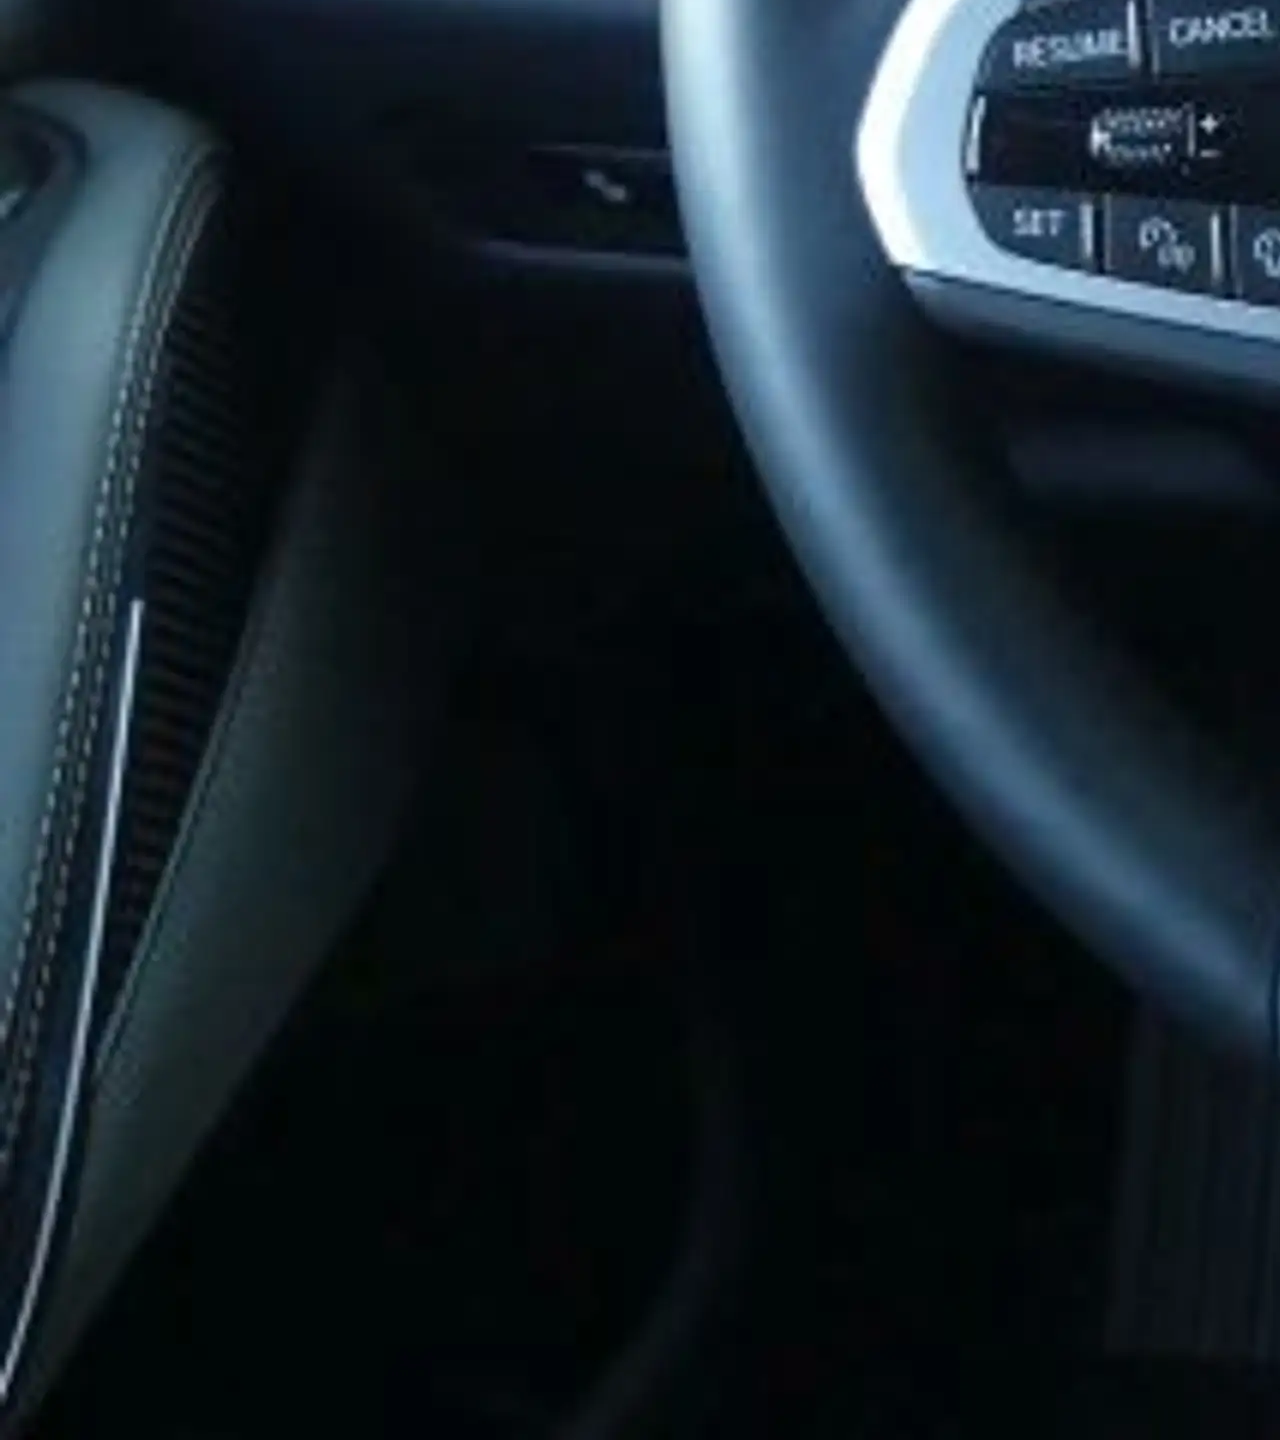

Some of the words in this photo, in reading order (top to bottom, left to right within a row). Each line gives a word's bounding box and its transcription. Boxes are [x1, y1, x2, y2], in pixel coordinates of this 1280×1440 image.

[1168, 9, 1276, 47] CANCEL
[1012, 28, 1127, 68] RESUME
[1013, 209, 1065, 238] SET
